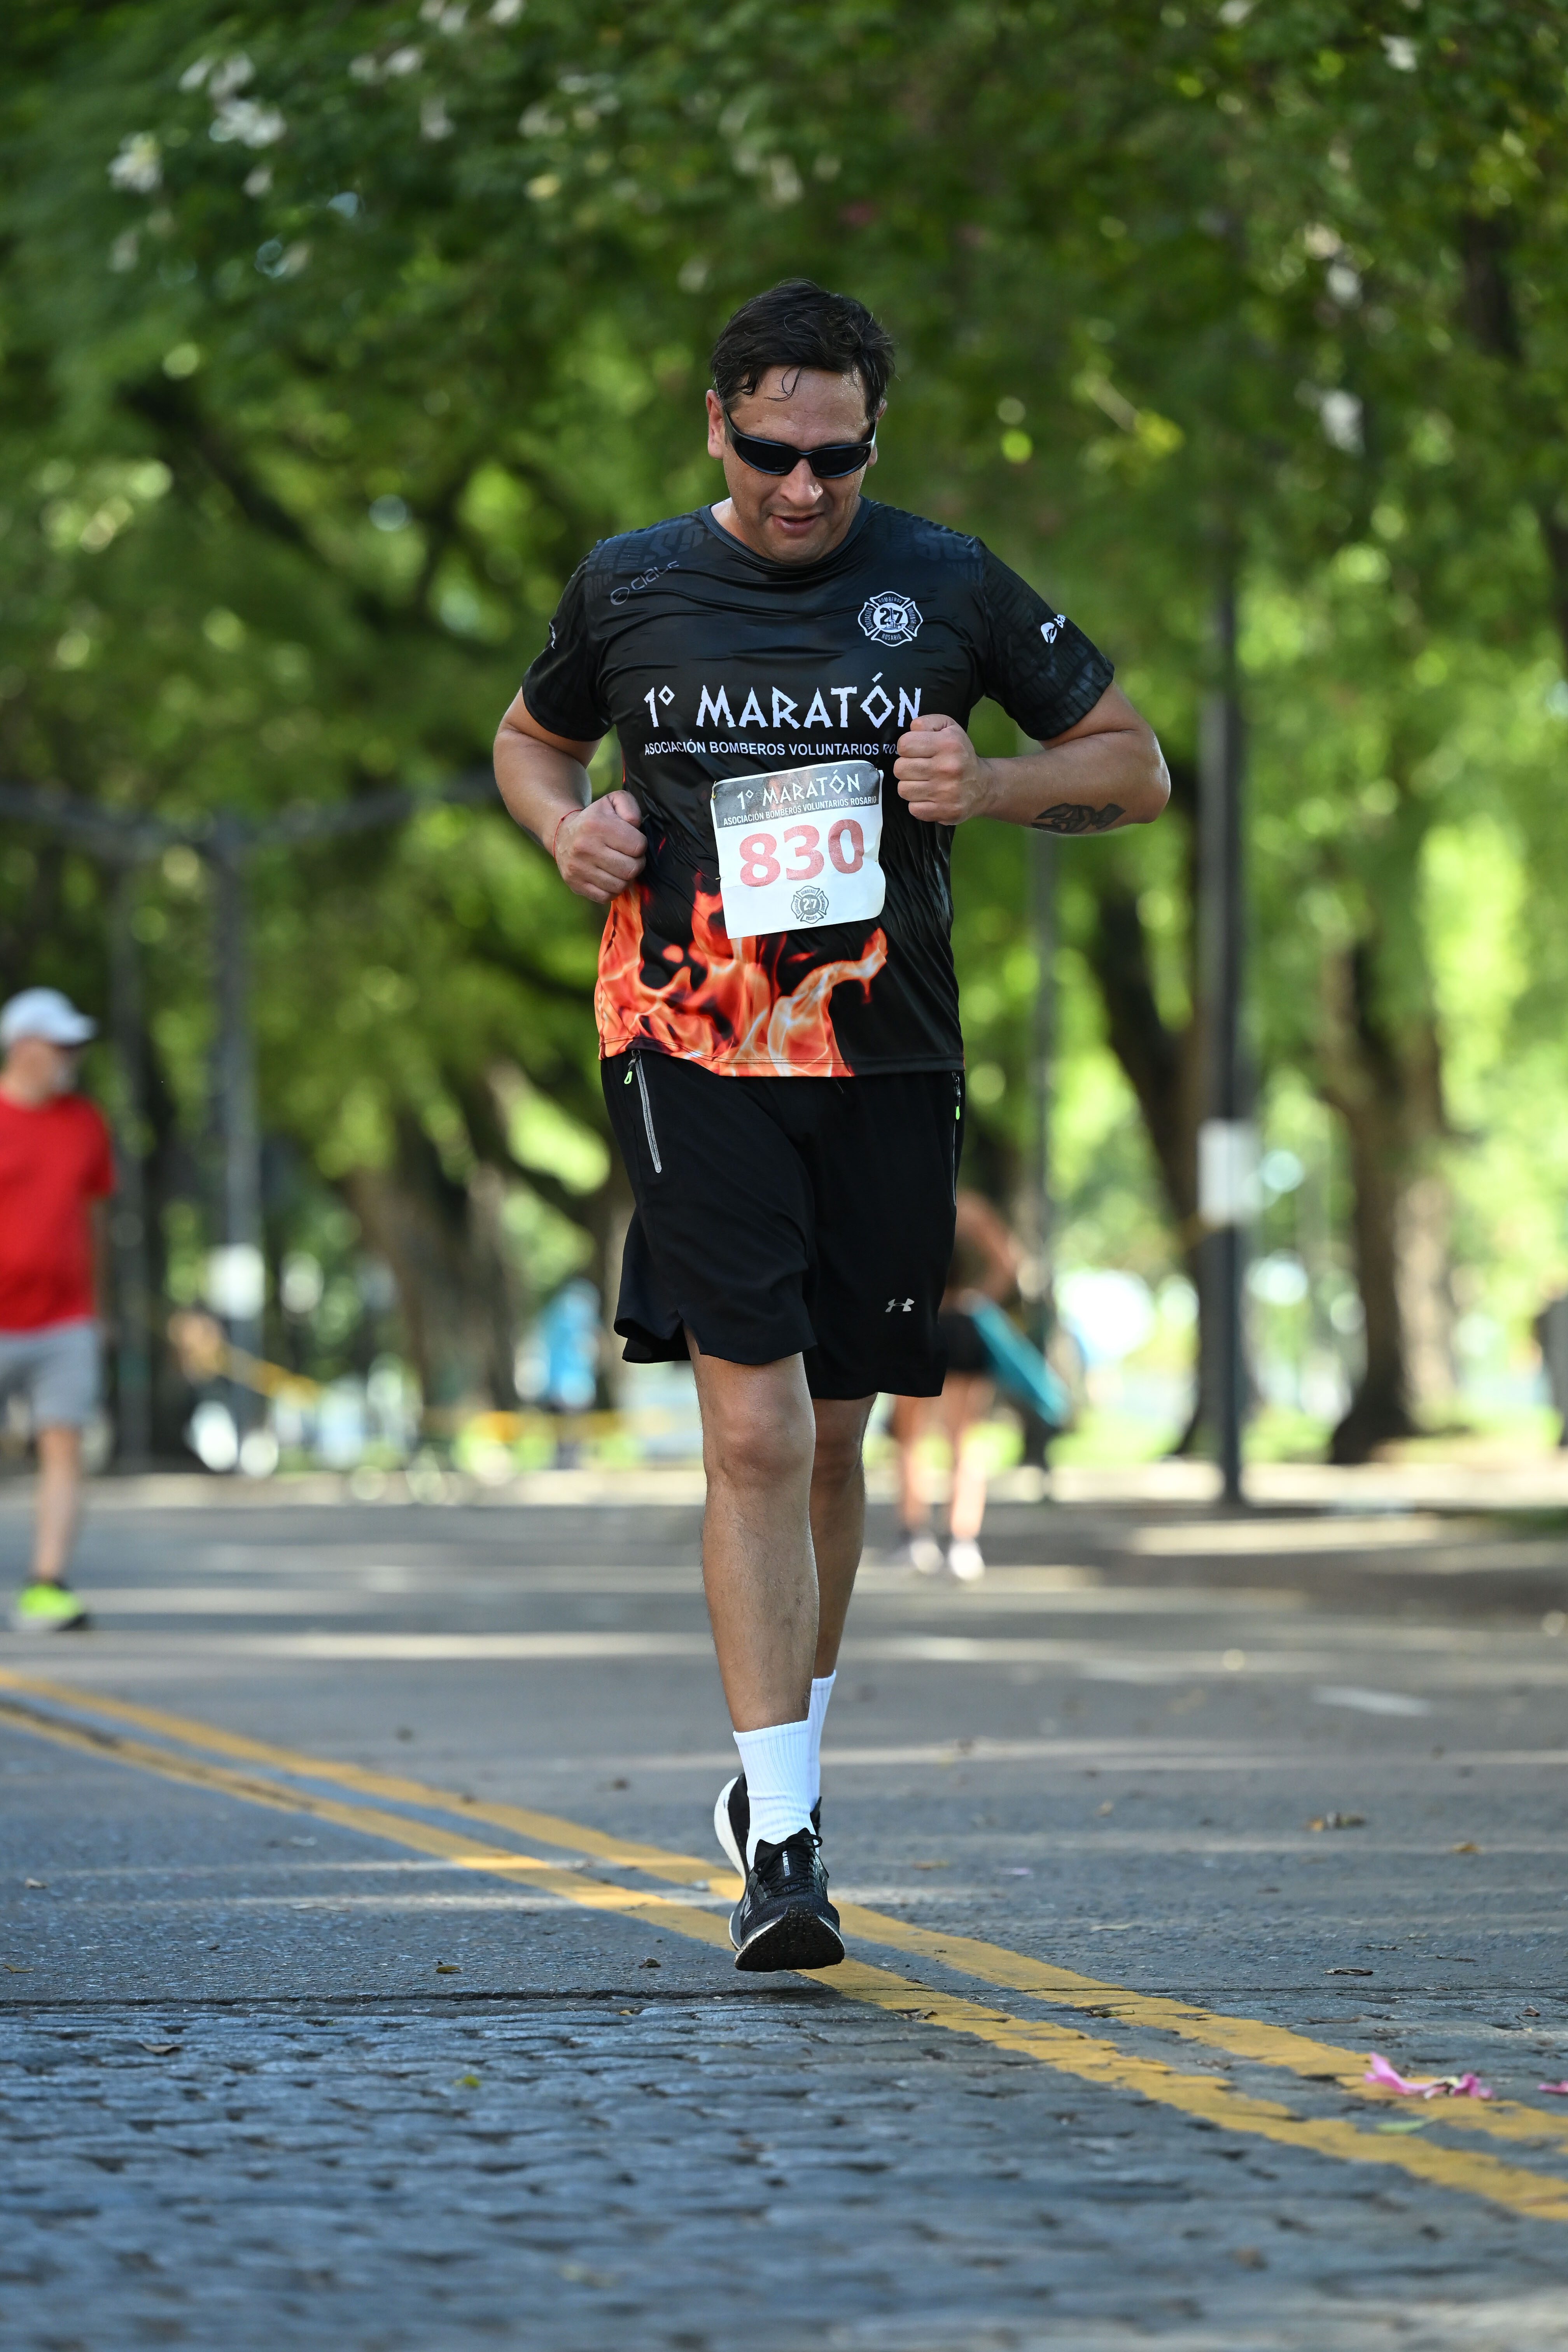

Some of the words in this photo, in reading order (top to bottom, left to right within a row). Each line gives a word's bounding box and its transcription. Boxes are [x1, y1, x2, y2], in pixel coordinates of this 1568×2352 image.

[879, 607, 903, 625] 27
[696, 672, 921, 729] MARATÓN
[644, 738, 706, 756] ASOCIACIÓN
[709, 741, 786, 756] BOMBEROS
[788, 743, 879, 756] VOLUNTARIOS
[762, 769, 860, 806] MARATÓN
[723, 811, 764, 826] ASOCIACIÓN
[765, 805, 802, 819] BOMBEROS
[803, 798, 849, 812] VOLUNTARIOS
[850, 796, 877, 806] ROSARIO
[739, 819, 864, 887] 830
[802, 898, 817, 911] 27
